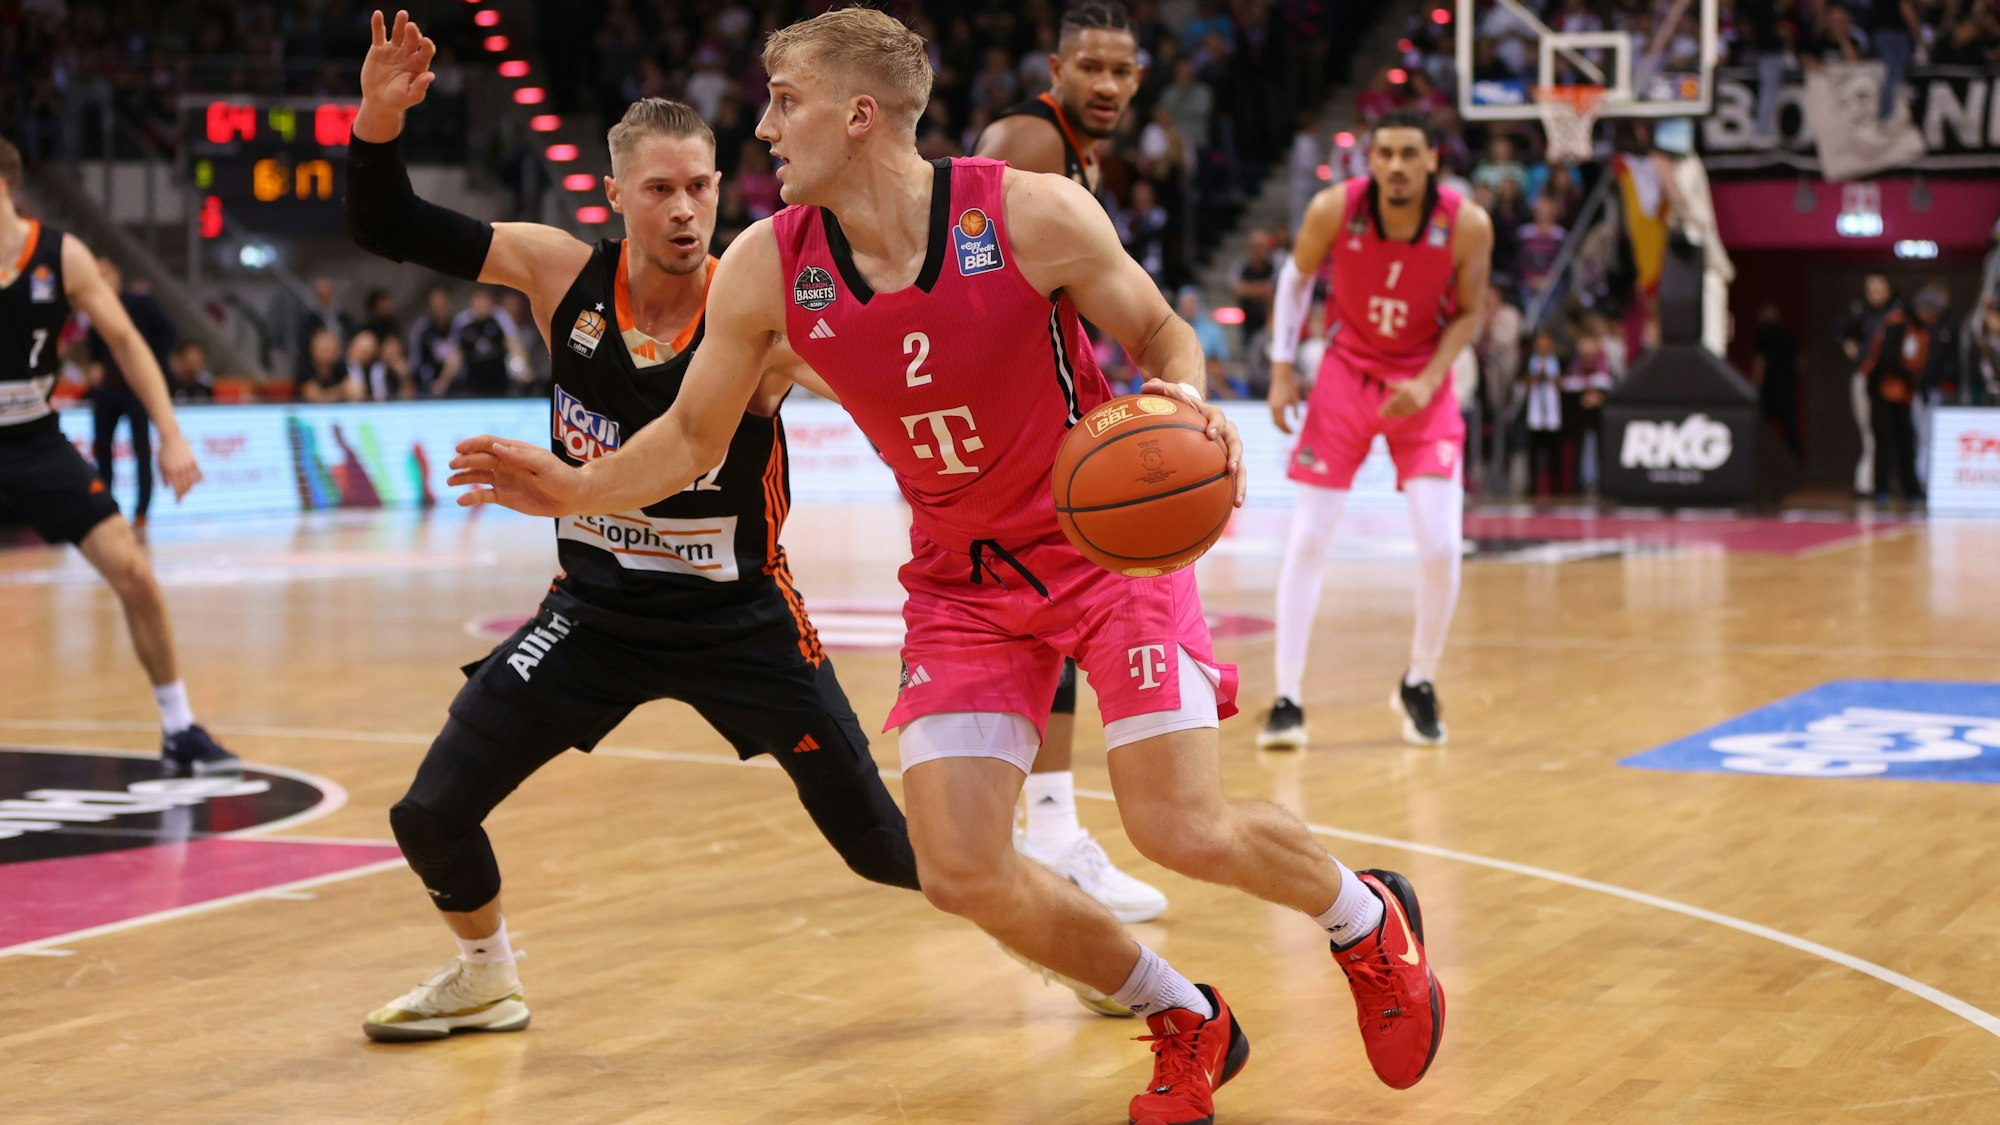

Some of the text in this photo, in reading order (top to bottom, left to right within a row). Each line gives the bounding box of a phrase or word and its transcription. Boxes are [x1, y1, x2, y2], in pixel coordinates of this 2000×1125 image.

[964, 252, 998, 270] BBL
[1385, 260, 1404, 290] 1
[796, 287, 834, 302] BASKETS
[1367, 296, 1409, 339] T
[29, 328, 49, 369] 7
[573, 341, 588, 354] ulm
[903, 331, 933, 388] 2
[900, 405, 985, 475] T
[1096, 409, 1134, 432] BBL
[1619, 413, 1734, 470] RKG
[1127, 644, 1167, 691] T
